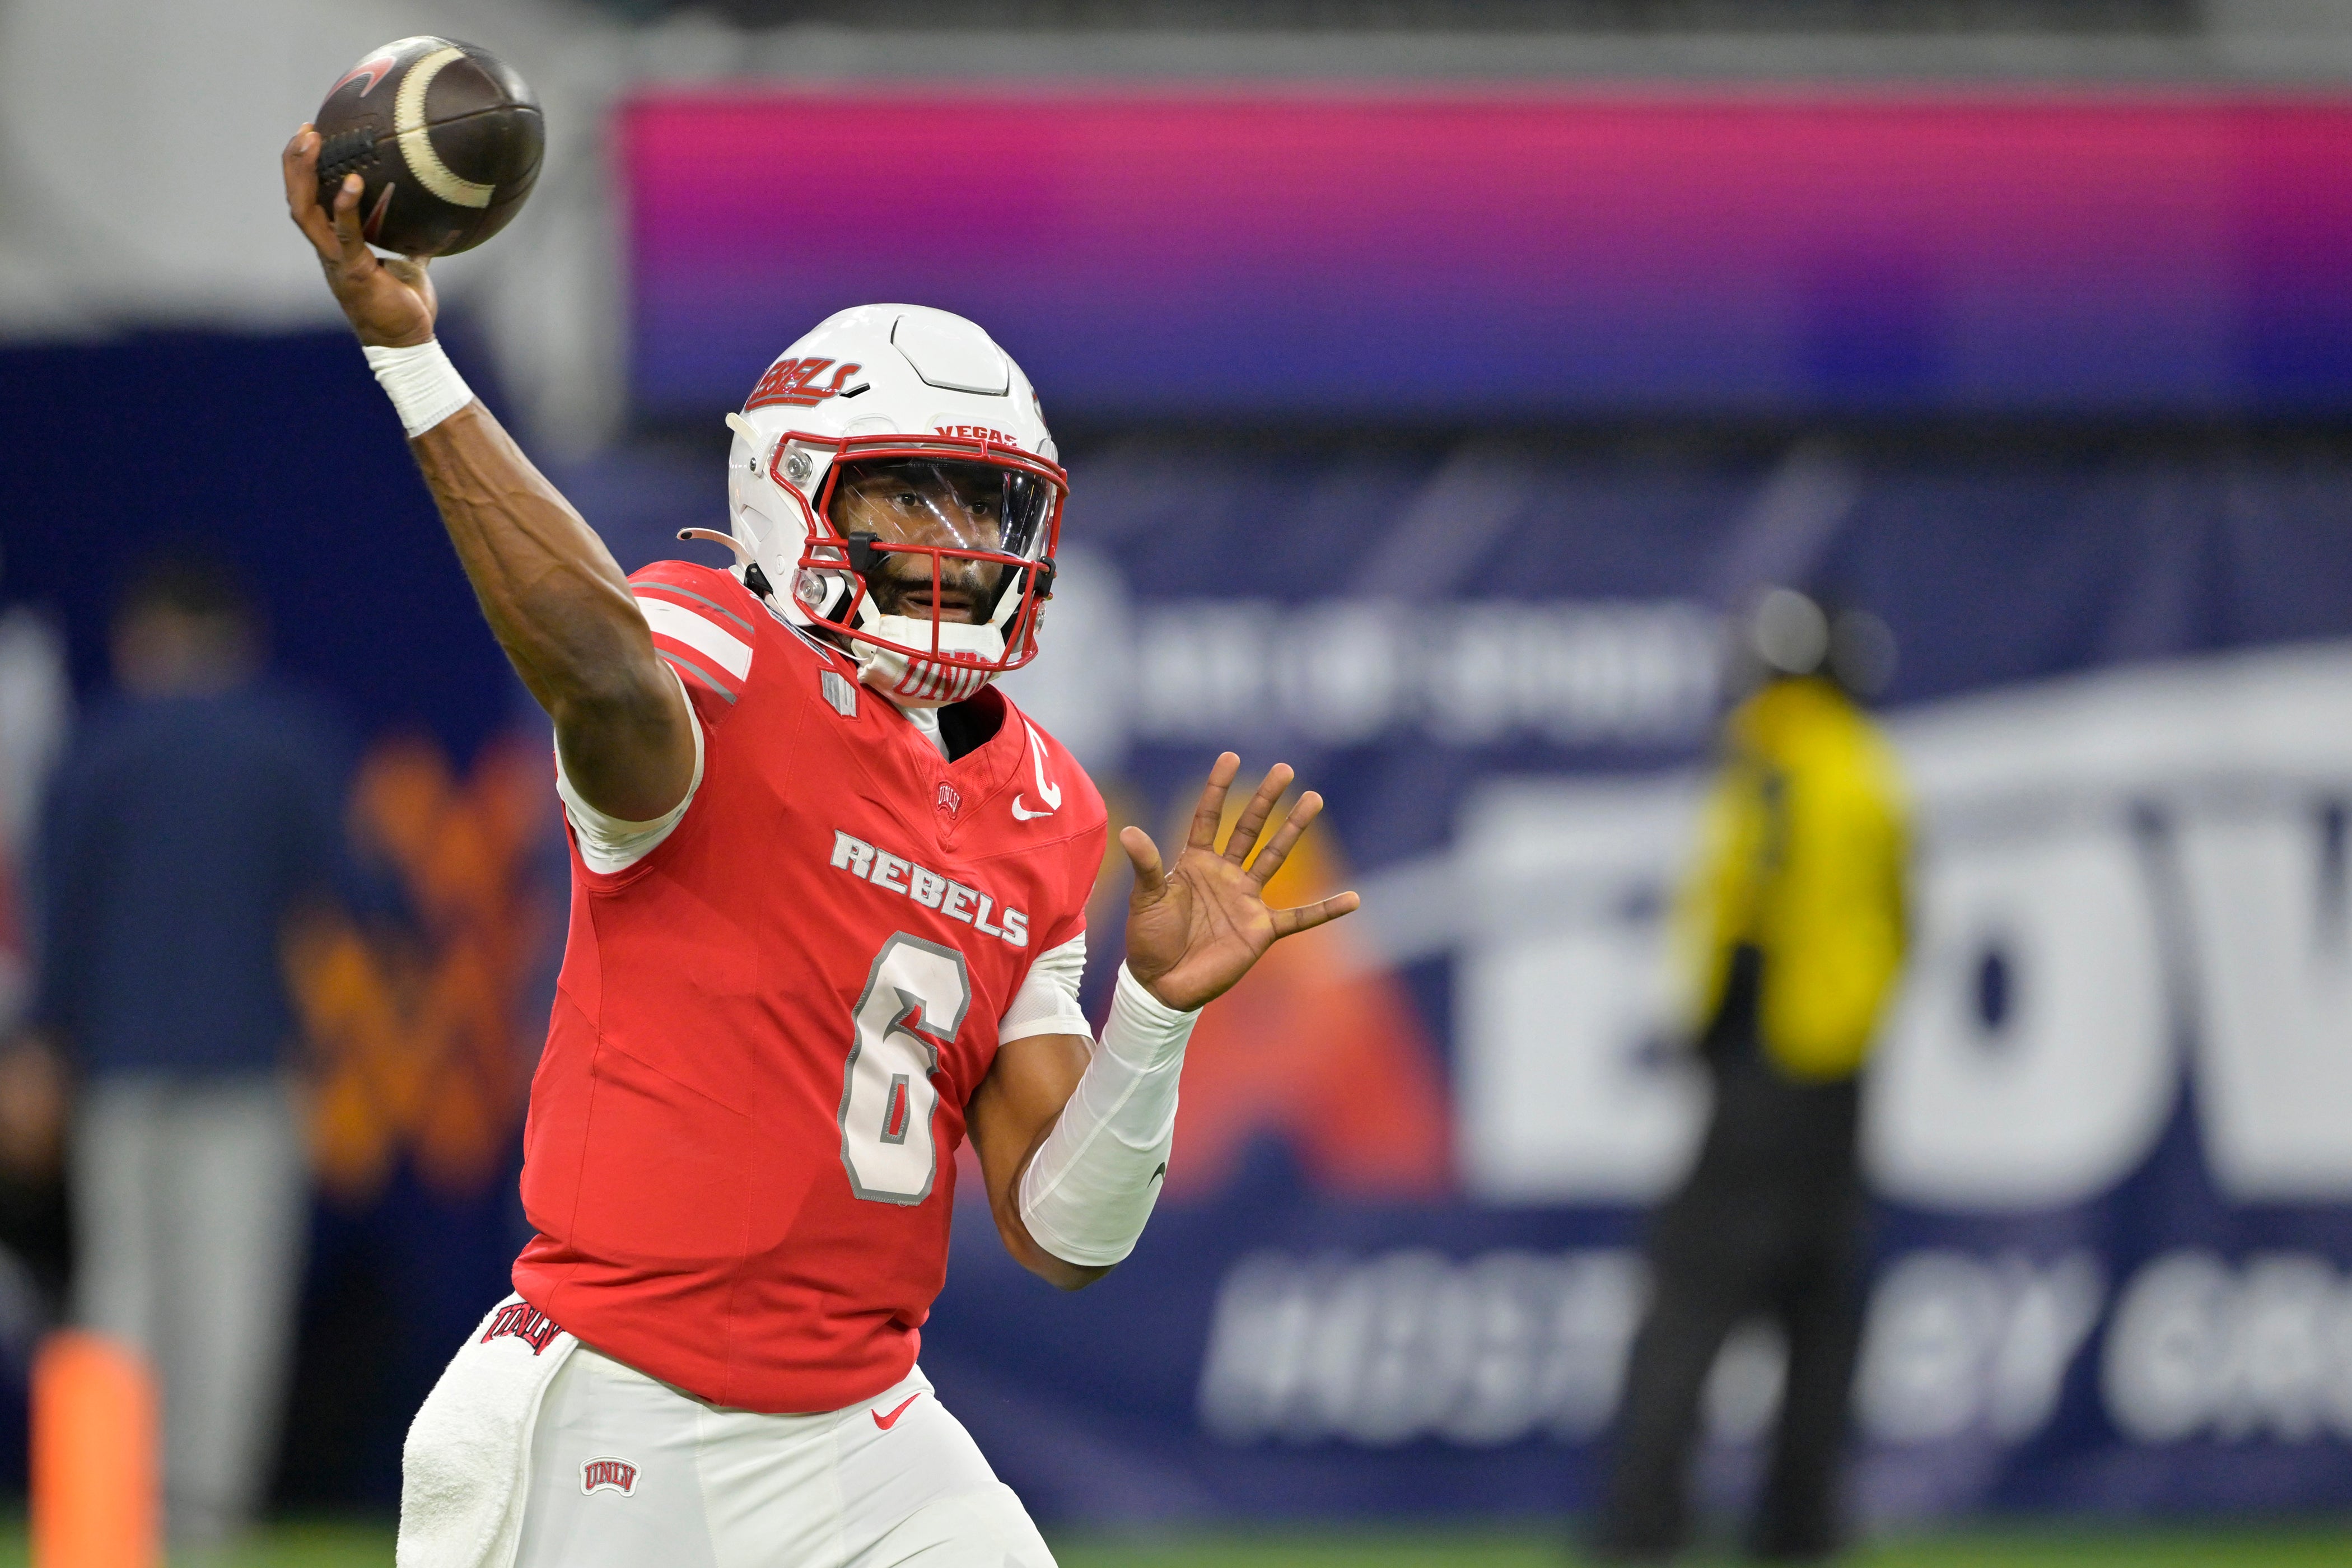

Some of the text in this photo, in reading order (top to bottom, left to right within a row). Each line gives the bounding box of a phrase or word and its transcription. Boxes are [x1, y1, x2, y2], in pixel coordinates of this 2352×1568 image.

[744, 357, 862, 413] EBELS
[934, 425, 1018, 446] VEGAS
[938, 785, 960, 813] UNLV
[830, 829, 1029, 947] REBELS
[837, 930, 972, 1206] 6
[480, 1302, 565, 1356] UNLV
[585, 1460, 637, 1492] UNLV
